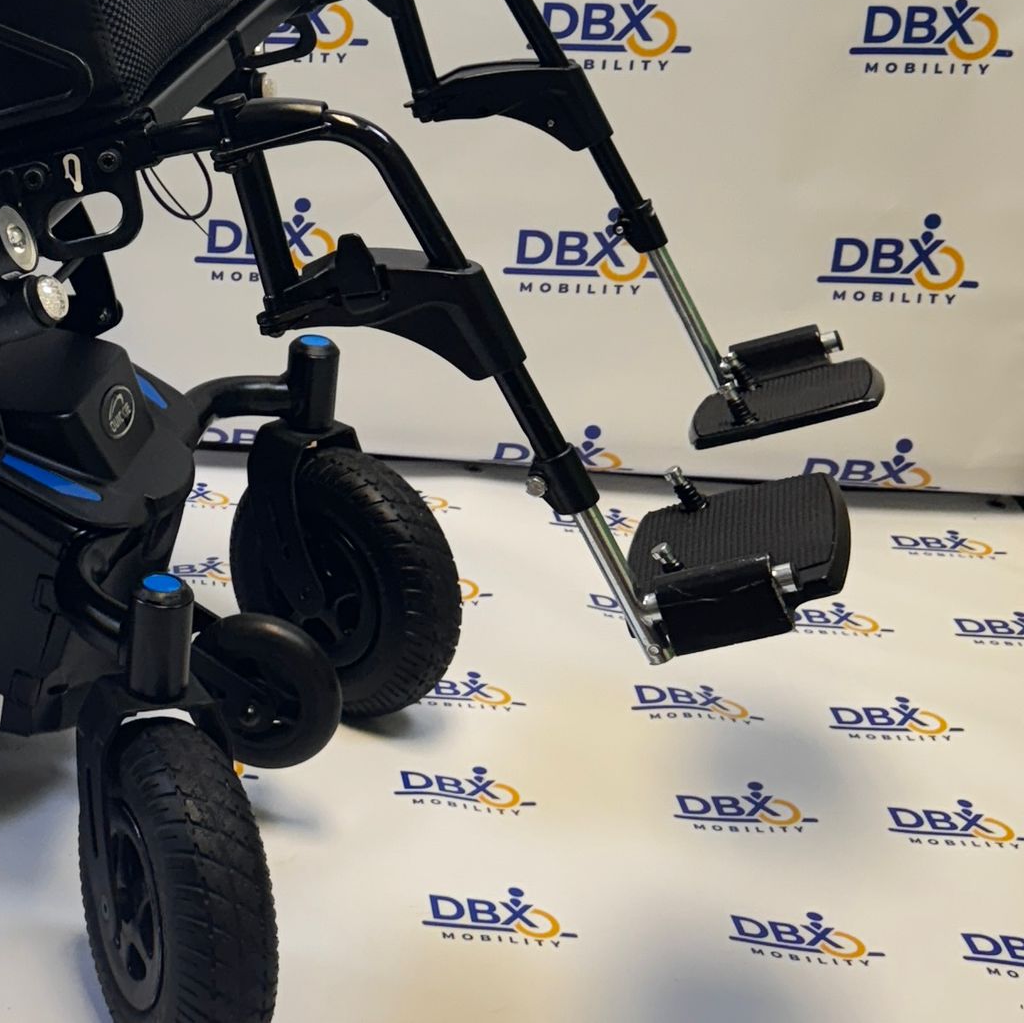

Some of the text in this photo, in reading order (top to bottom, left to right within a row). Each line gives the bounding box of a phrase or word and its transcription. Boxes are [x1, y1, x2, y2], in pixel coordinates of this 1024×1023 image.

[543, 2, 657, 41] DBX
[863, 6, 979, 45] DBX
[570, 59, 669, 71] BILITY
[865, 62, 989, 75] MOBILITY
[207, 219, 314, 257] DX
[516, 228, 631, 269] DBX
[831, 238, 945, 276] DBX
[520, 282, 640, 295] MOBILITY
[833, 290, 956, 305] MOBILITY
[890, 535, 976, 551] DBX
[795, 608, 863, 627] BX
[434, 680, 492, 699] BX
[634, 685, 729, 711] DBX
[650, 713, 750, 725] MOBILITY
[829, 707, 929, 727] DBX
[848, 733, 952, 742] MOBILITY
[400, 770, 501, 800] DBX
[412, 799, 520, 816] MOBILITY
[676, 795, 781, 817] DBX
[693, 823, 805, 833] MOBILITY
[887, 807, 994, 834] DBX
[908, 837, 1020, 849] MOBILITY
[429, 894, 539, 928] DBX
[442, 932, 560, 948] MOBILITY
[730, 914, 845, 949] DBX
[750, 947, 869, 966] MOBILITY
